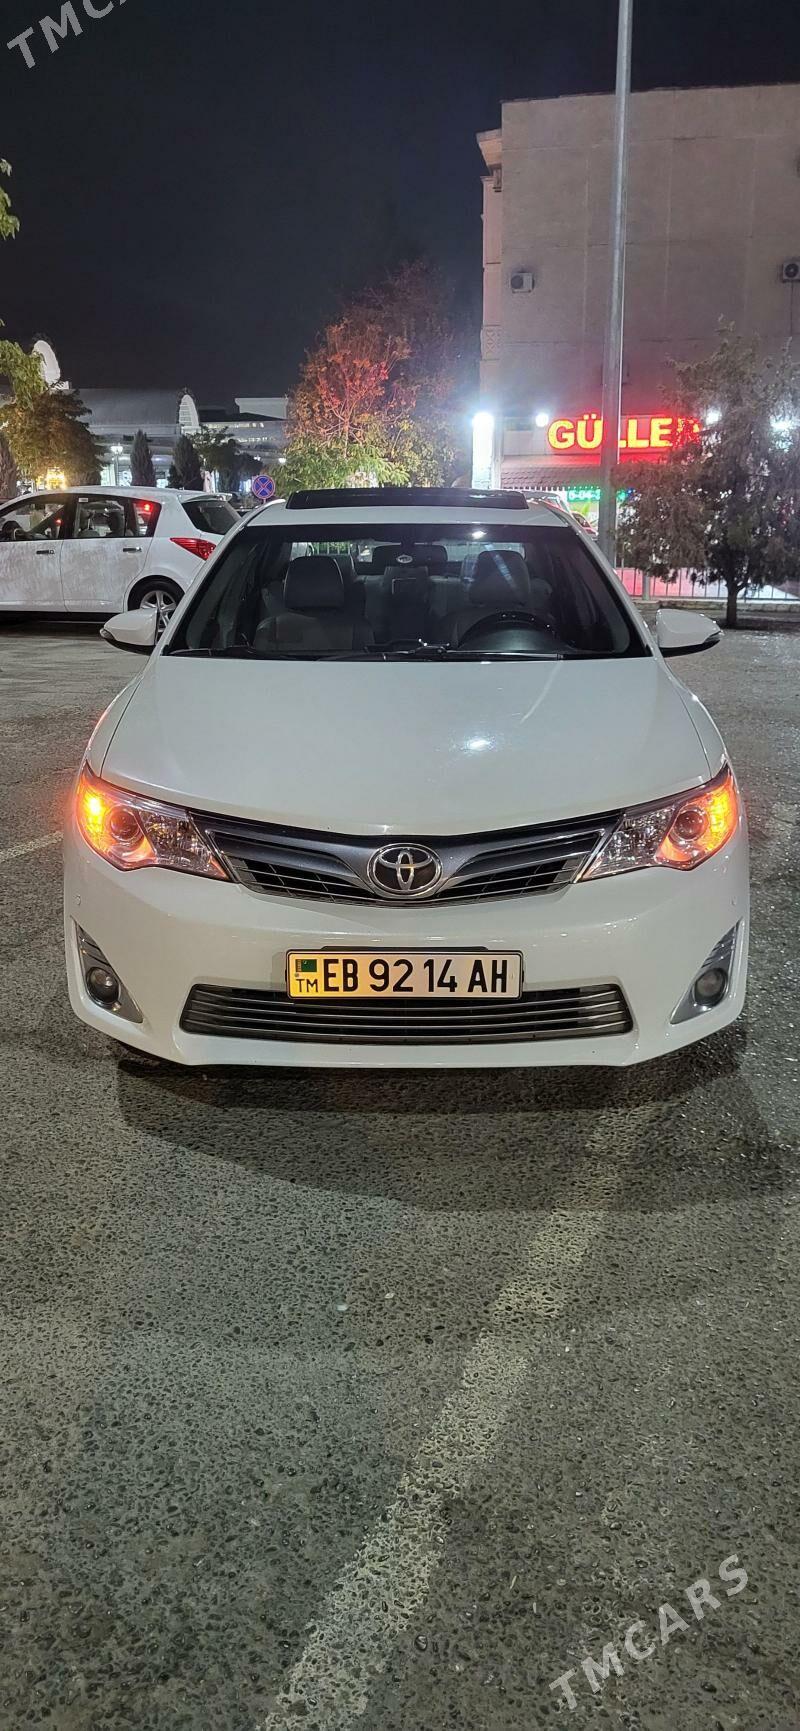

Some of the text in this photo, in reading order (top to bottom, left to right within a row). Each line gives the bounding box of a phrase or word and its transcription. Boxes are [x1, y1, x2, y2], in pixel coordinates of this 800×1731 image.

[547, 413, 701, 449] GÜLE
[295, 978, 319, 993] TM
[323, 958, 508, 993] EB 92 14 AH
